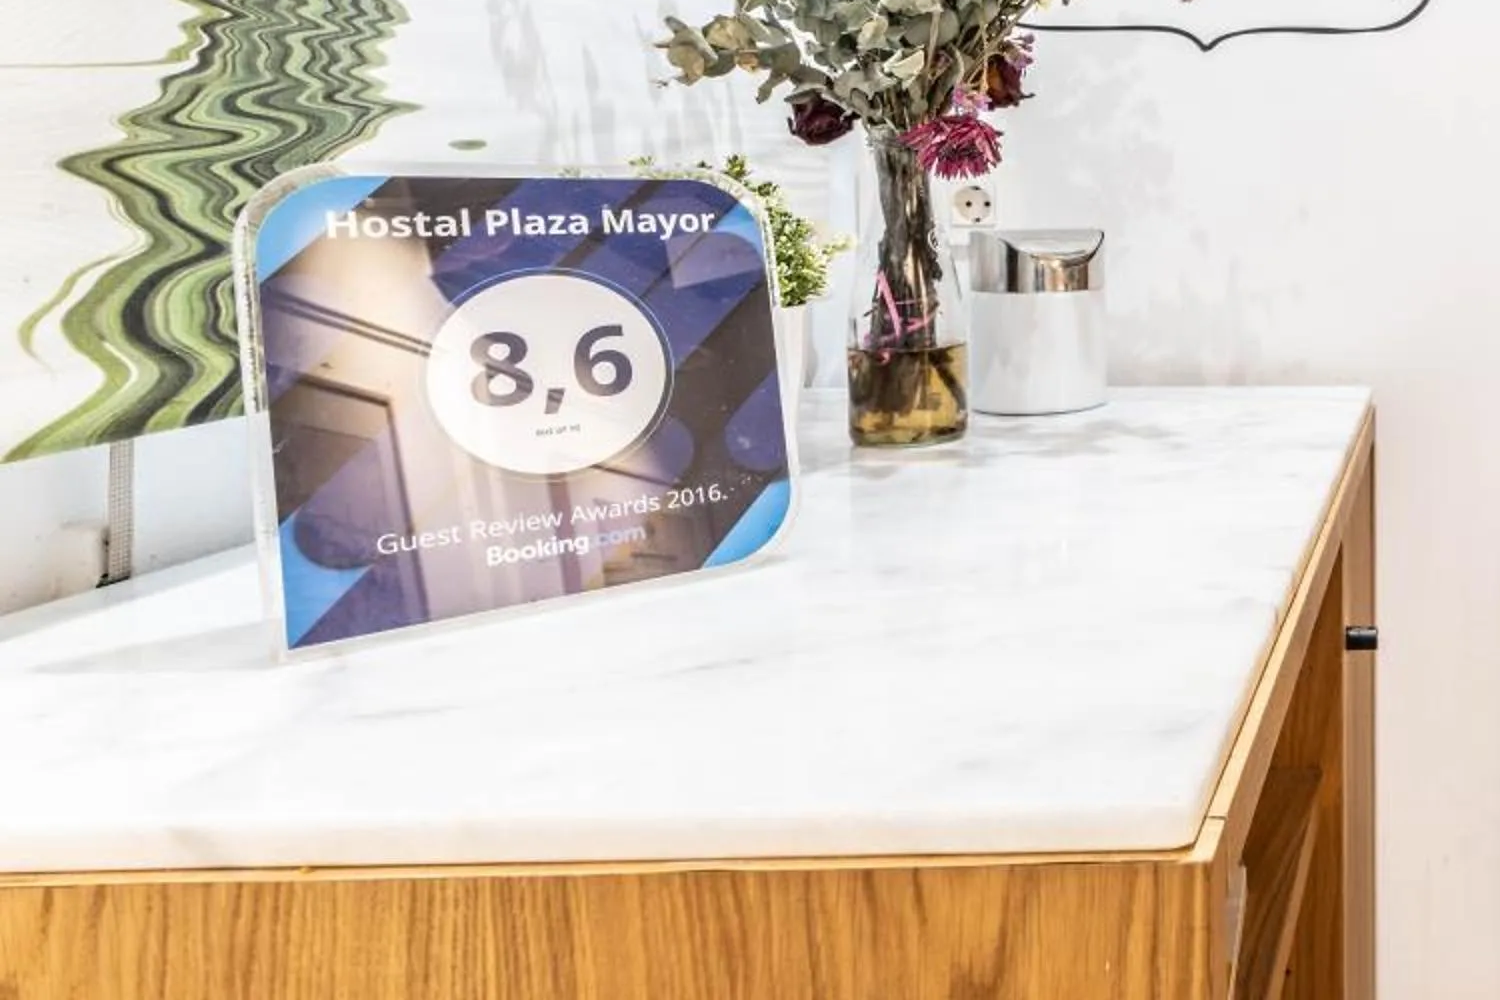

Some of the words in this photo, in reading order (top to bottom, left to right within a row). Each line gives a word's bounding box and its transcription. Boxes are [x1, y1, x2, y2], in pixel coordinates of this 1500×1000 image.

[325, 207, 472, 239] Hostal
[485, 207, 591, 238] Plaza
[601, 206, 715, 241] Mayor
[468, 323, 635, 415] 8,6
[376, 527, 462, 556] Guest
[469, 511, 564, 540] Review
[570, 492, 661, 526] Awards
